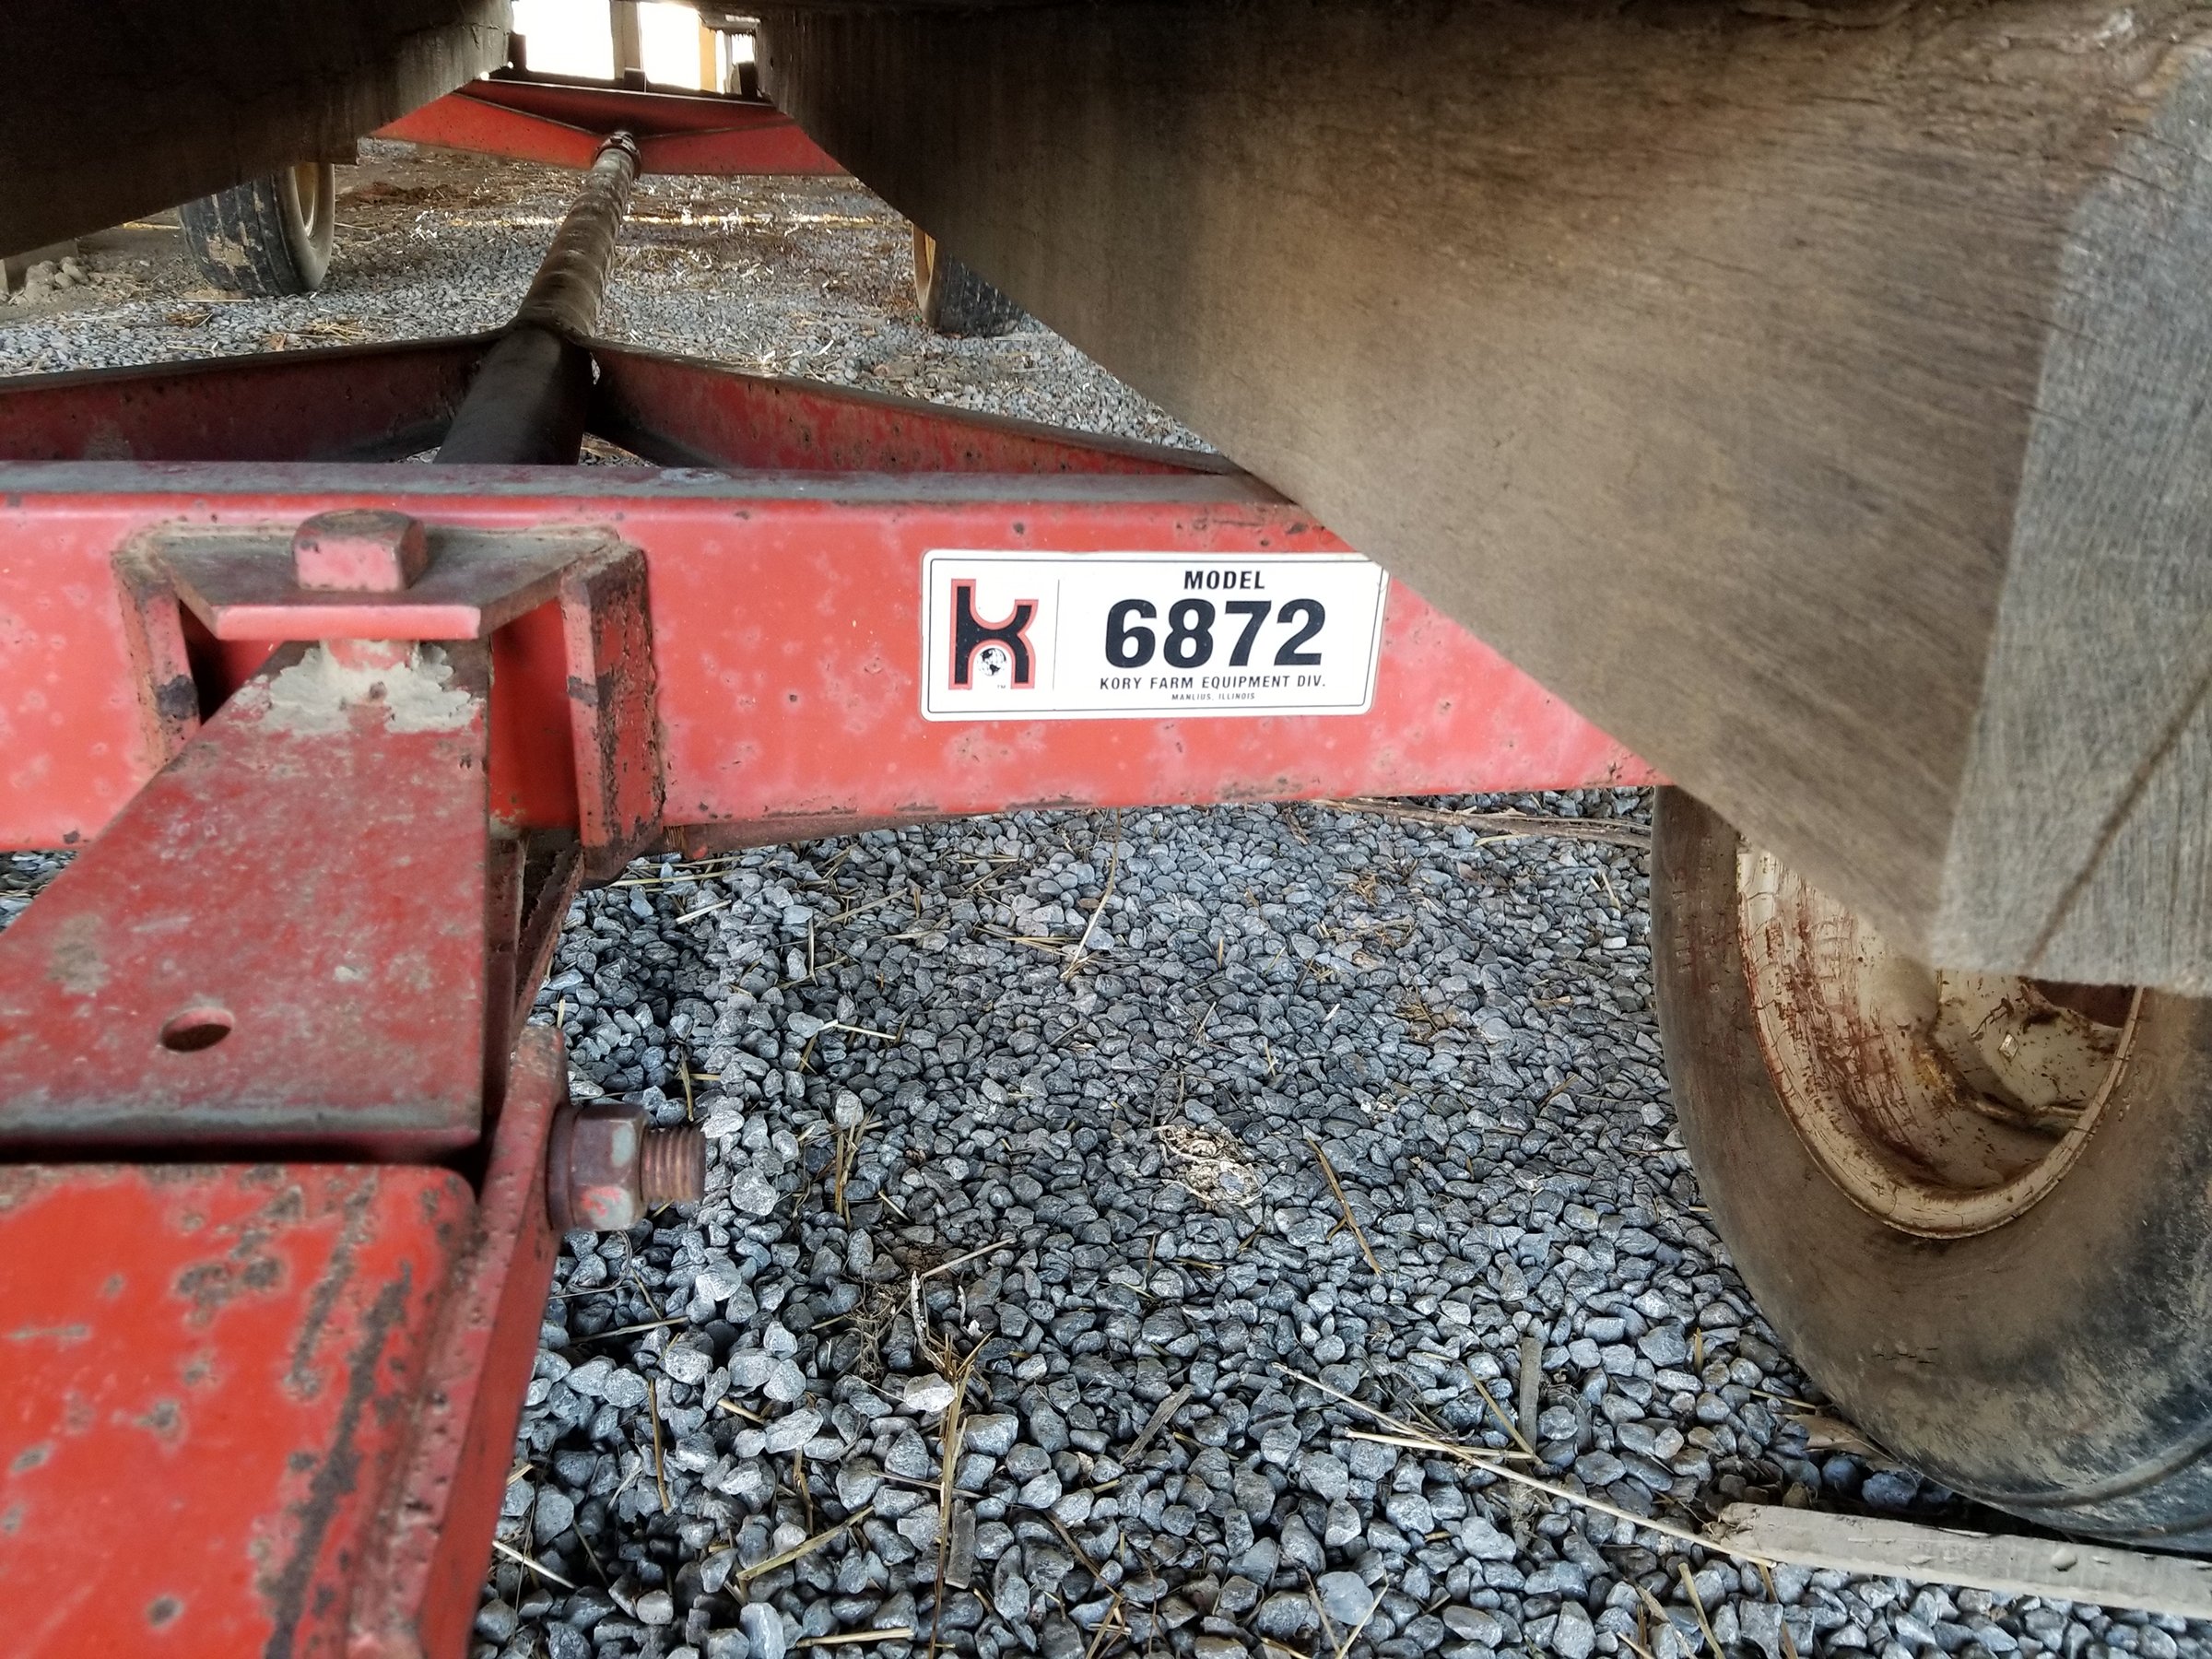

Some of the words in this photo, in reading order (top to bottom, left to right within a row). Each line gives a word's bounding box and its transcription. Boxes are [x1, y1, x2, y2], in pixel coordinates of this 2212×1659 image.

[1183, 570, 1265, 591] MODEL
[1105, 598, 1326, 669] 6872
[1100, 677, 1142, 690] KORY
[1150, 677, 1194, 689] FARM
[1202, 675, 1290, 689] EQUIPMENT
[1297, 675, 1326, 688] DIV.
[1218, 692, 1256, 700] ILLINOIS
